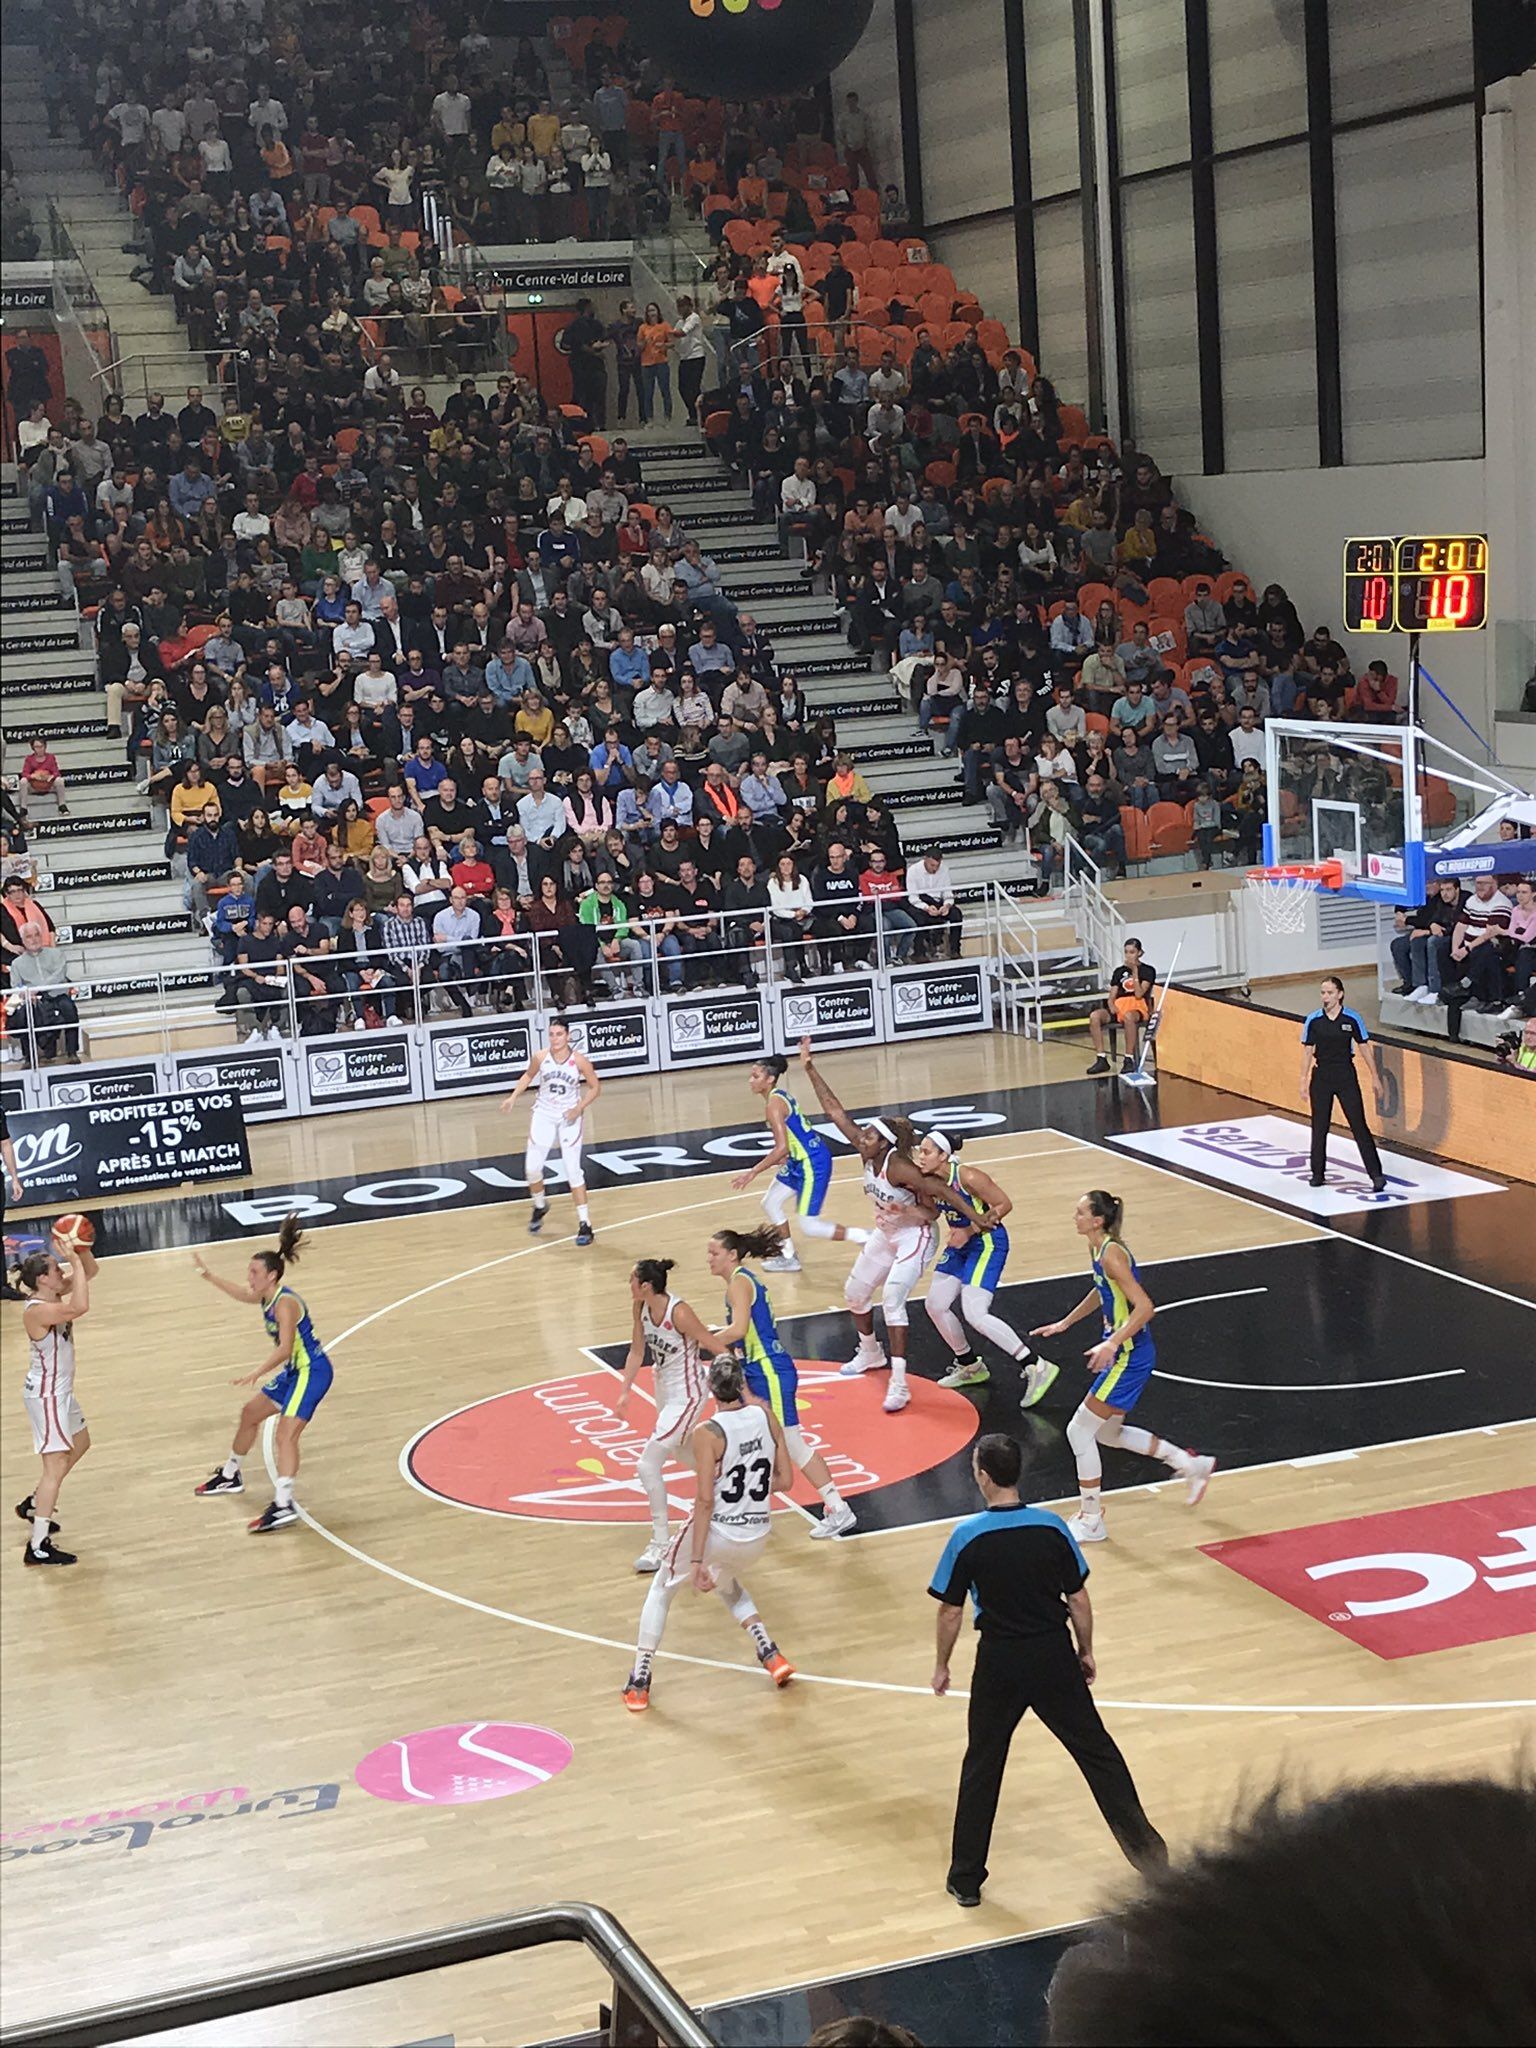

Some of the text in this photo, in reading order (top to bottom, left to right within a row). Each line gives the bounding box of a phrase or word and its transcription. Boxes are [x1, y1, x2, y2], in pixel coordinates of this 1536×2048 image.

[516, 271, 578, 287] Centre-Val
[581, 270, 594, 283] de
[597, 270, 625, 283] Loire
[15, 293, 46, 305] Loire
[1419, 542, 1483, 572] 2:01
[1362, 575, 1470, 620] 10 10
[6, 638, 75, 650] Centre-Val de Loire
[1, 679, 92, 695] gion Centre-Val de Loire
[837, 705, 872, 715] Centre-Val
[6, 730, 36, 740] Région
[38, 726, 79, 737] Centre-Val
[81, 724, 89, 733] de
[868, 748, 903, 758] Centre-Val
[914, 745, 931, 753] Loire
[98, 771, 107, 779] de
[109, 769, 128, 778] Loire
[900, 793, 937, 803] Centre-Val
[40, 817, 148, 835] Région Centre-Val de Loire
[57, 867, 167, 886] Région Centre-Val de Loire
[826, 880, 853, 891] NASA
[1007, 885, 1016, 893] de
[1017, 883, 1034, 892] Loire
[76, 918, 187, 939] Région Centre-Val de Loire
[95, 983, 128, 995] Région
[177, 975, 187, 985] de
[188, 973, 209, 984] Loire
[927, 983, 962, 995] Centre-
[818, 996, 854, 1008] Centre-
[928, 992, 977, 1006] Val de Loire
[706, 1010, 742, 1022] Centre-
[818, 1006, 869, 1020] Val de Loire
[589, 1023, 627, 1035] Centre-
[707, 1020, 757, 1034] Val de Loire
[470, 1038, 509, 1050] Centre-
[590, 1033, 642, 1048] Val de Loire
[348, 1053, 387, 1065] Centre-
[472, 1048, 526, 1063] Val de Loire
[220, 1067, 261, 1079] Centre-
[349, 1062, 404, 1078] Val de Loire
[92, 1083, 135, 1095] Centre-
[239, 1077, 279, 1090] de Loire
[549, 1083, 566, 1096] 23
[89, 1104, 169, 1124] PROFITEZ
[172, 1100, 195, 1114] DE
[197, 1094, 233, 1111] VOS
[129, 1115, 202, 1149] -15%
[97, 1142, 241, 1175] APRÈS LE MATCH
[23, 1173, 77, 1188] de Bruxelles
[100, 1161, 242, 1188] sur présentation de votre Rebond
[721, 1458, 771, 1504] 33
